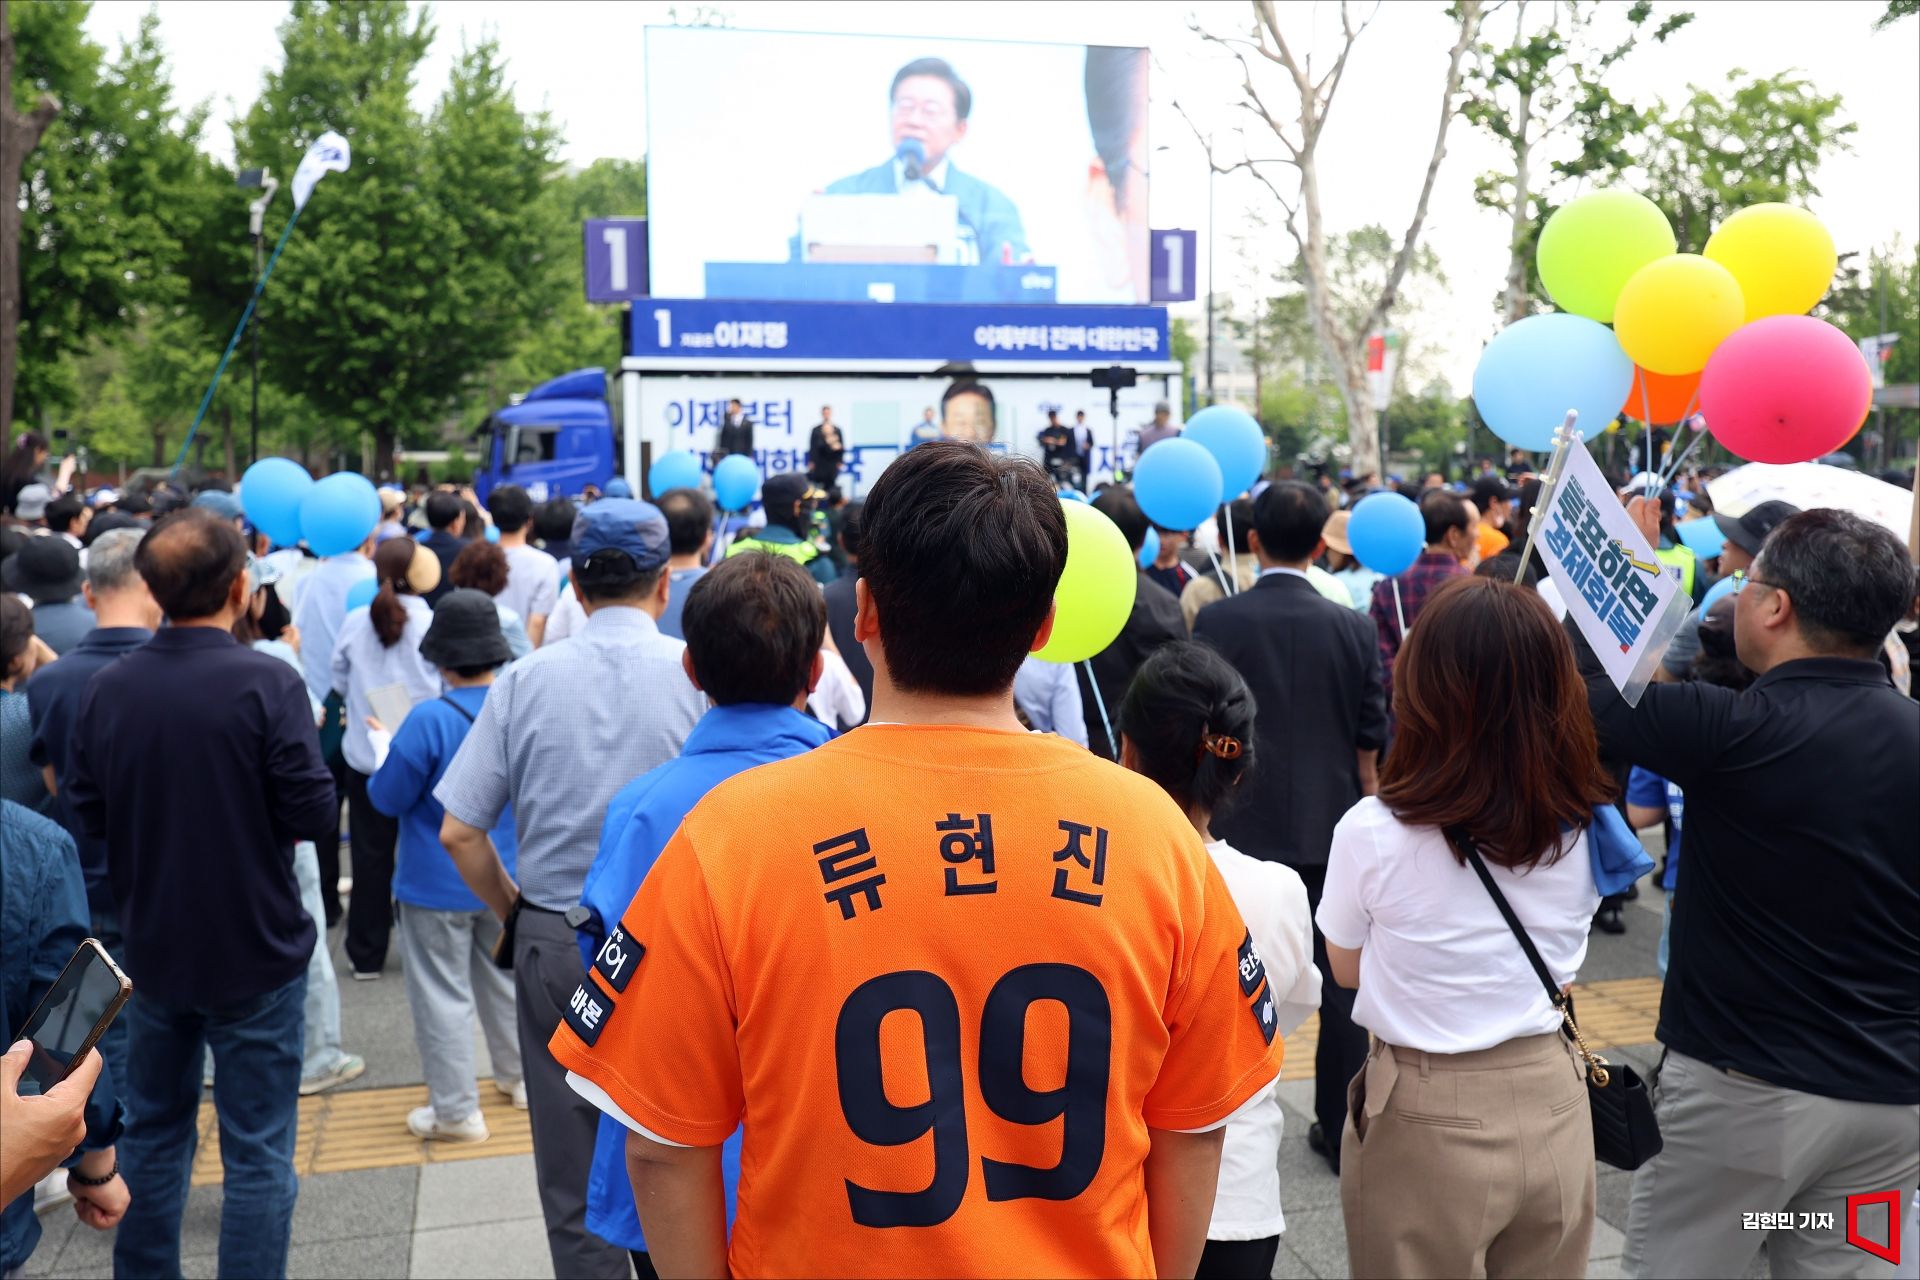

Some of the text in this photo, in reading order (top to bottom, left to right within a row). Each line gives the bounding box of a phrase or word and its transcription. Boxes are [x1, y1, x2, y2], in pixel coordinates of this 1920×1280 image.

[603, 227, 628, 291] 1
[1163, 235, 1183, 294] 1
[653, 308, 672, 348] 1
[714, 321, 788, 349] 이재명
[1544, 511, 1642, 654] 경제회복
[1557, 479, 1659, 626] 투표하면
[834, 962, 1112, 1229] 99
